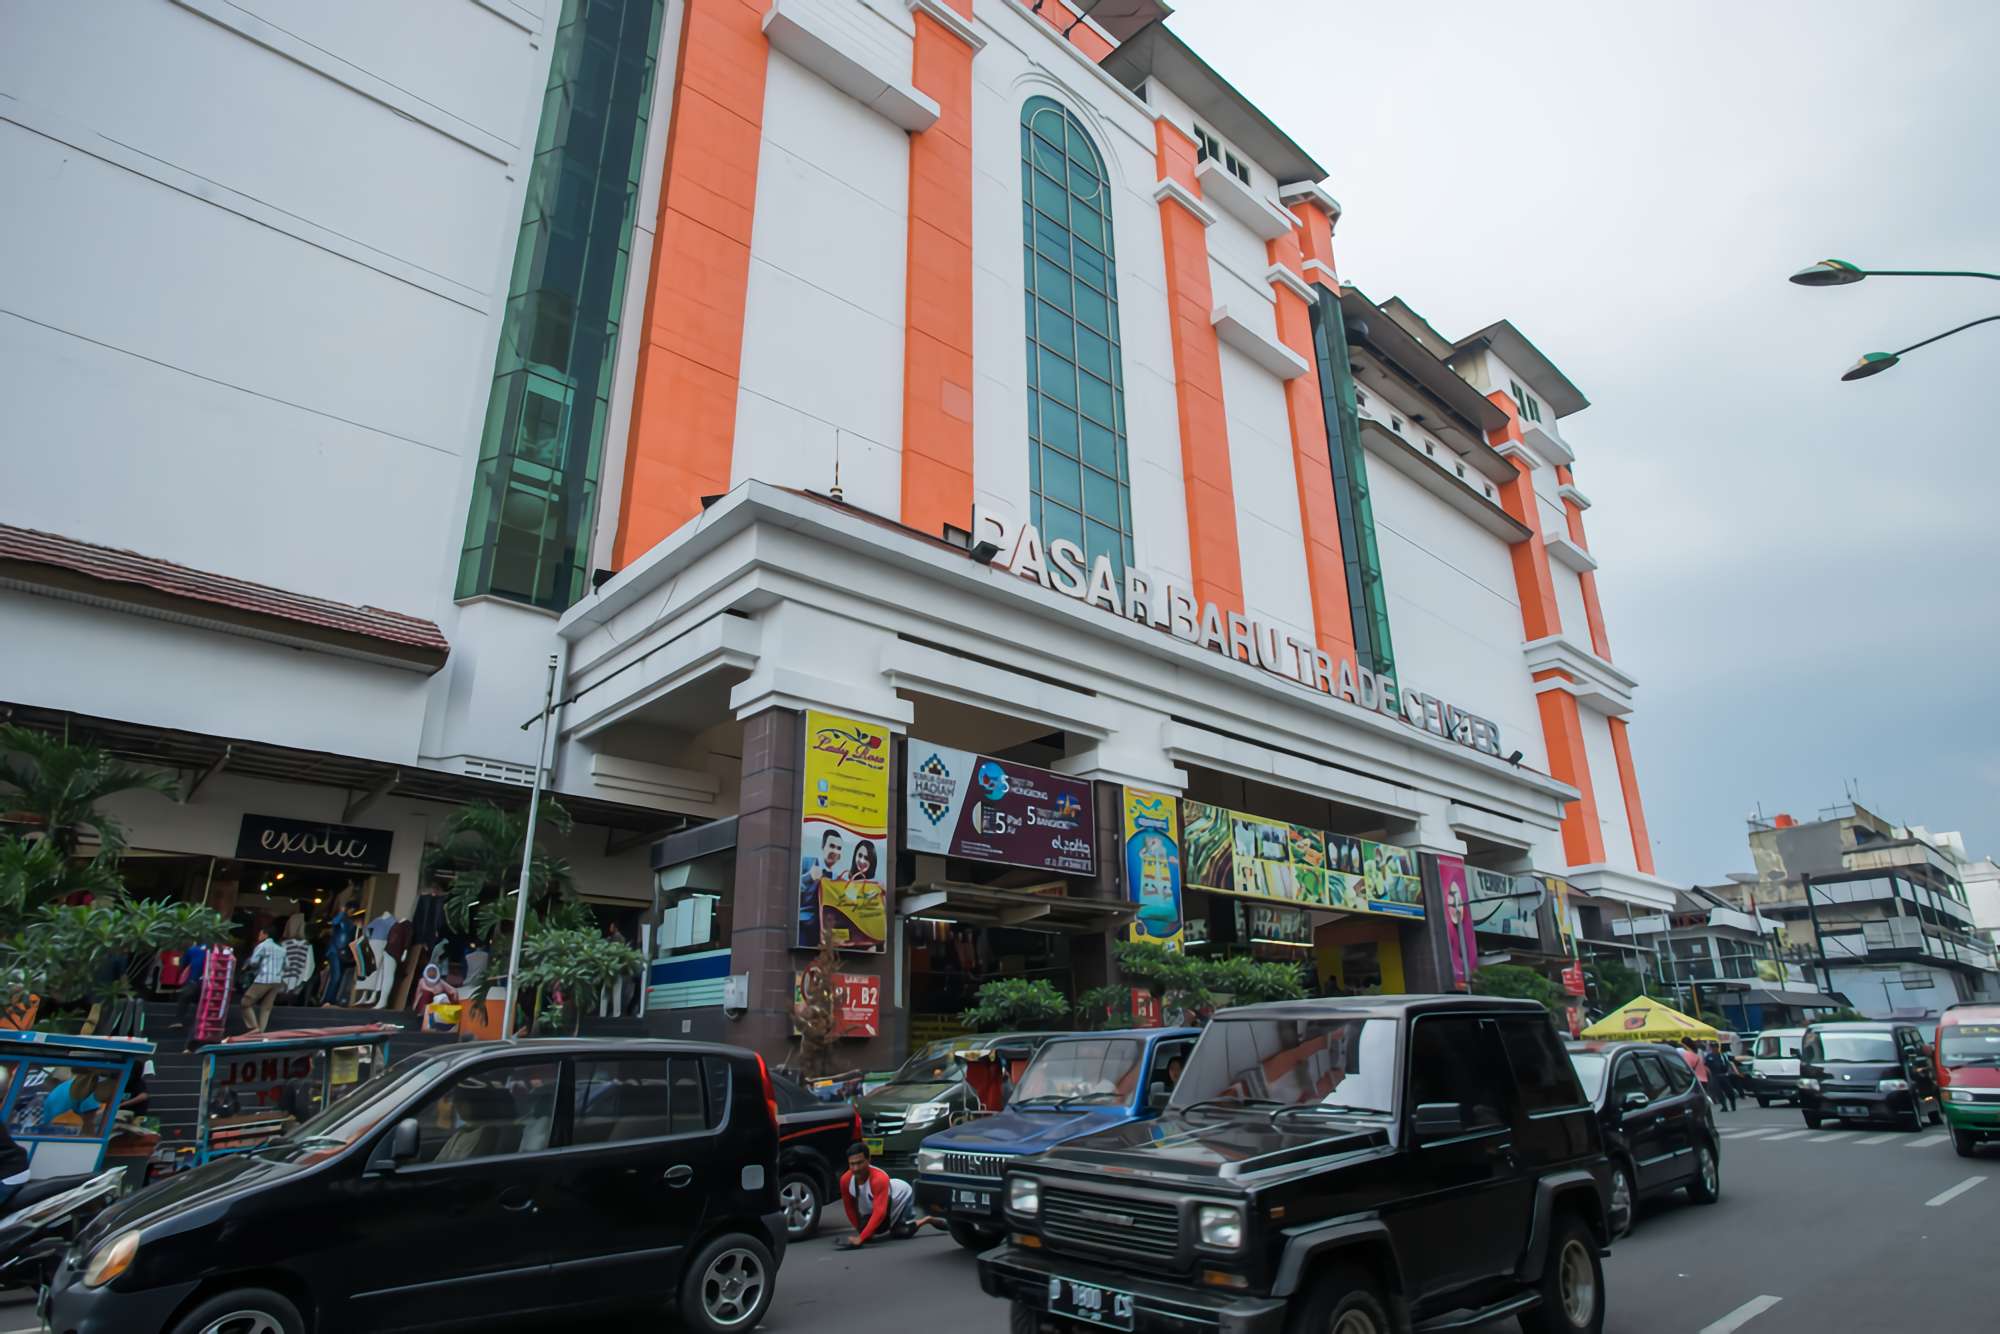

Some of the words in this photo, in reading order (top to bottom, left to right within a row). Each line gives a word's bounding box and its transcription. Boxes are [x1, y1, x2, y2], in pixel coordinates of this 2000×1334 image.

[972, 504, 1157, 629] PASAR
[1167, 577, 1282, 671] BARU
[1285, 636, 1400, 719] TRADE
[1401, 686, 1502, 757] CENTER
[995, 811, 1006, 834] 5
[1027, 805, 1036, 825] 5
